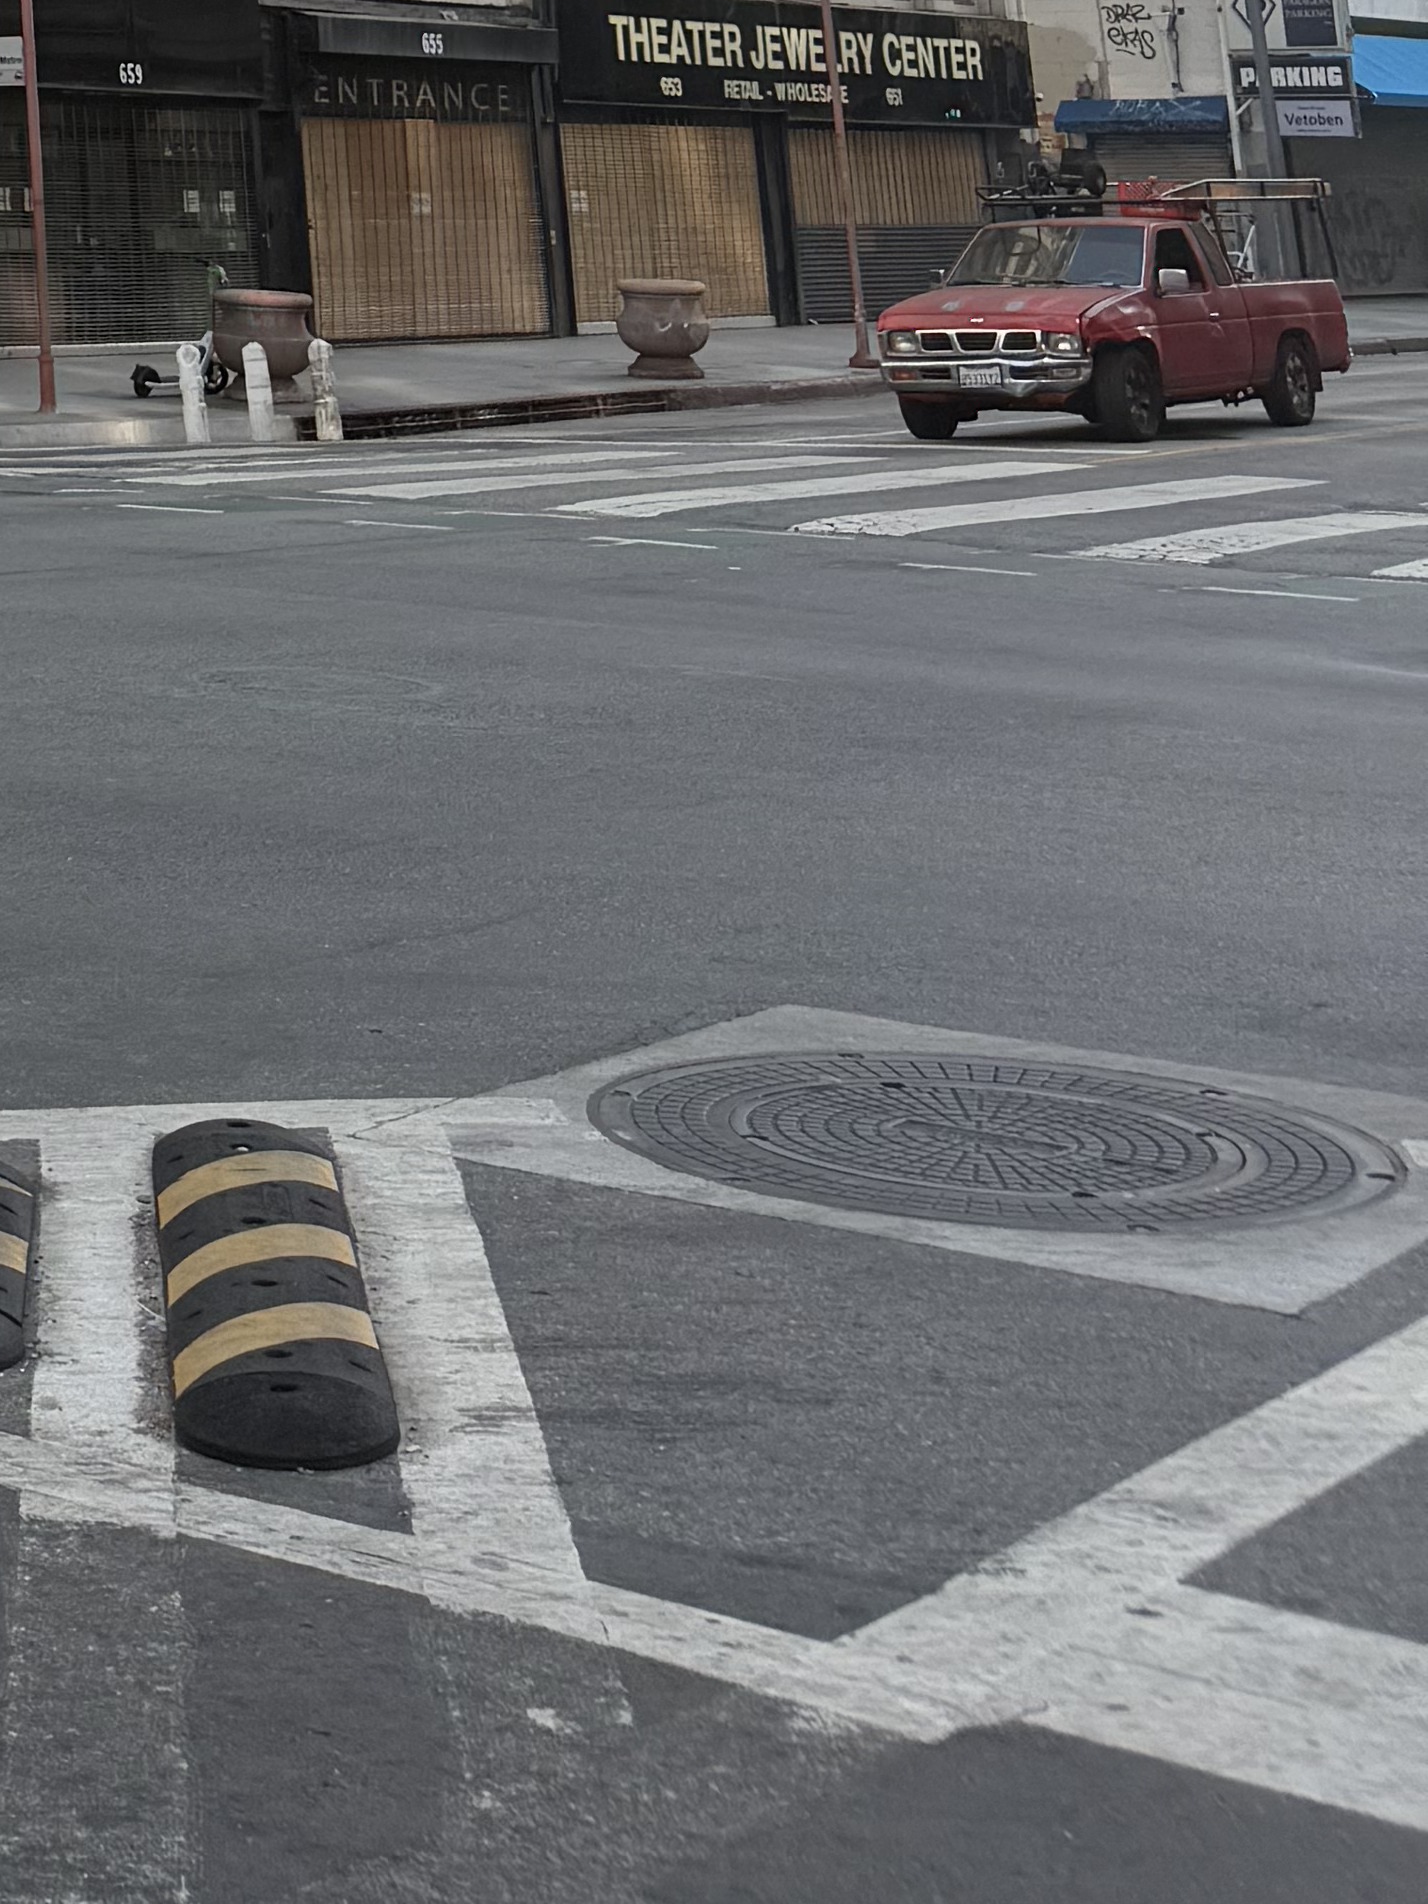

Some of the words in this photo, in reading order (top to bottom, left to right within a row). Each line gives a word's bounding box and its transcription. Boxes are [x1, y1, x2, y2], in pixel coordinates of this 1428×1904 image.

[1285, 9, 1332, 18] PARKING
[422, 32, 444, 55] 655
[608, 14, 745, 69] THEATER
[749, 24, 874, 75] JEWERY
[882, 32, 984, 81] CENTER
[119, 62, 143, 85] 659
[313, 74, 511, 113] ENTRANCE
[660, 76, 683, 98] 653
[723, 78, 764, 102] RETAIL
[775, 81, 849, 105] WHOLESAE
[1284, 112, 1344, 127] Vetoben
